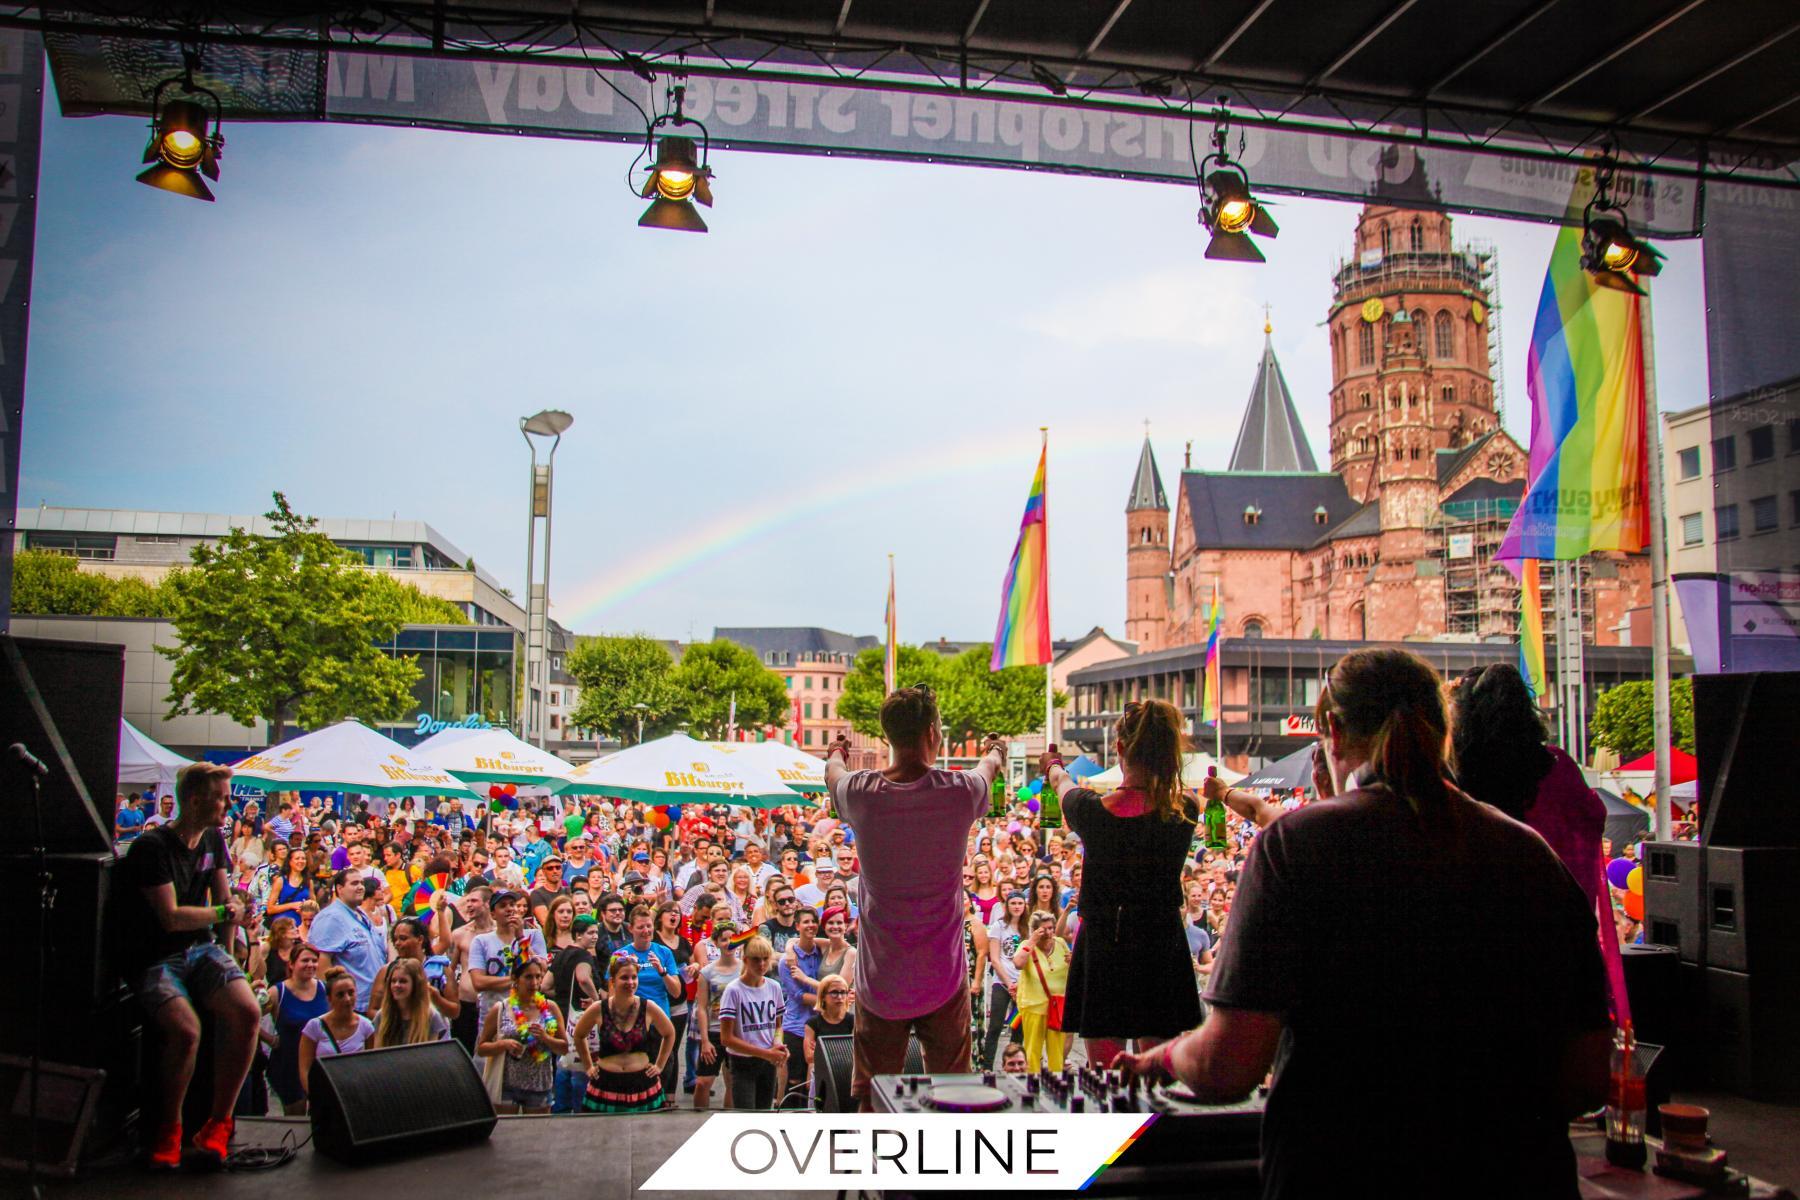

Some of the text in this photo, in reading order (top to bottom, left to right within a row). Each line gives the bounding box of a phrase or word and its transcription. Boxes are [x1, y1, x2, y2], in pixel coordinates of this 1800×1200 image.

[380, 764, 450, 783] Bitburger
[475, 756, 544, 773] Bitburger
[665, 771, 744, 790] Bitburger
[741, 1000, 776, 1025] NYC
